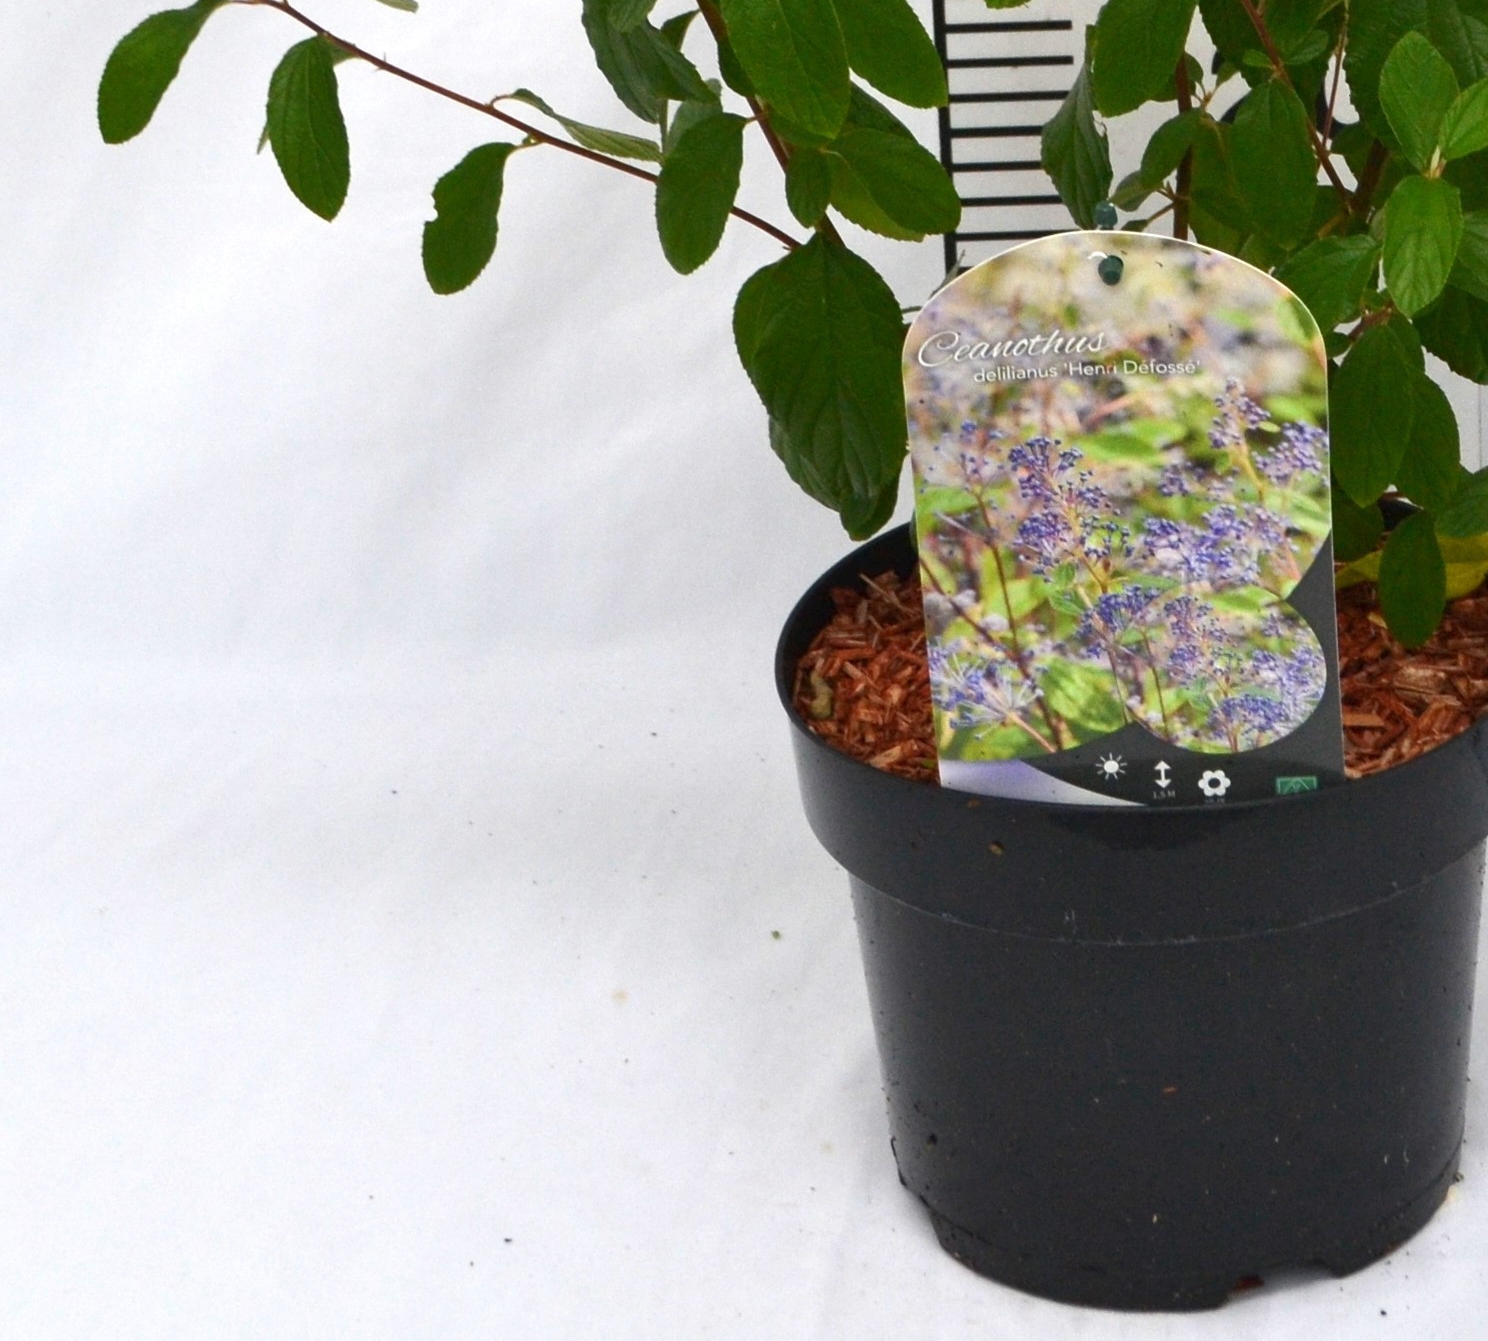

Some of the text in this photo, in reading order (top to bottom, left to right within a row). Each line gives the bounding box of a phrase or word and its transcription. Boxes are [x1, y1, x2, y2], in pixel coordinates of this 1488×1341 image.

[917, 328, 1106, 368] Ceanothus
[973, 364, 1059, 384] delilianus
[1063, 360, 1118, 378] 'Henri
